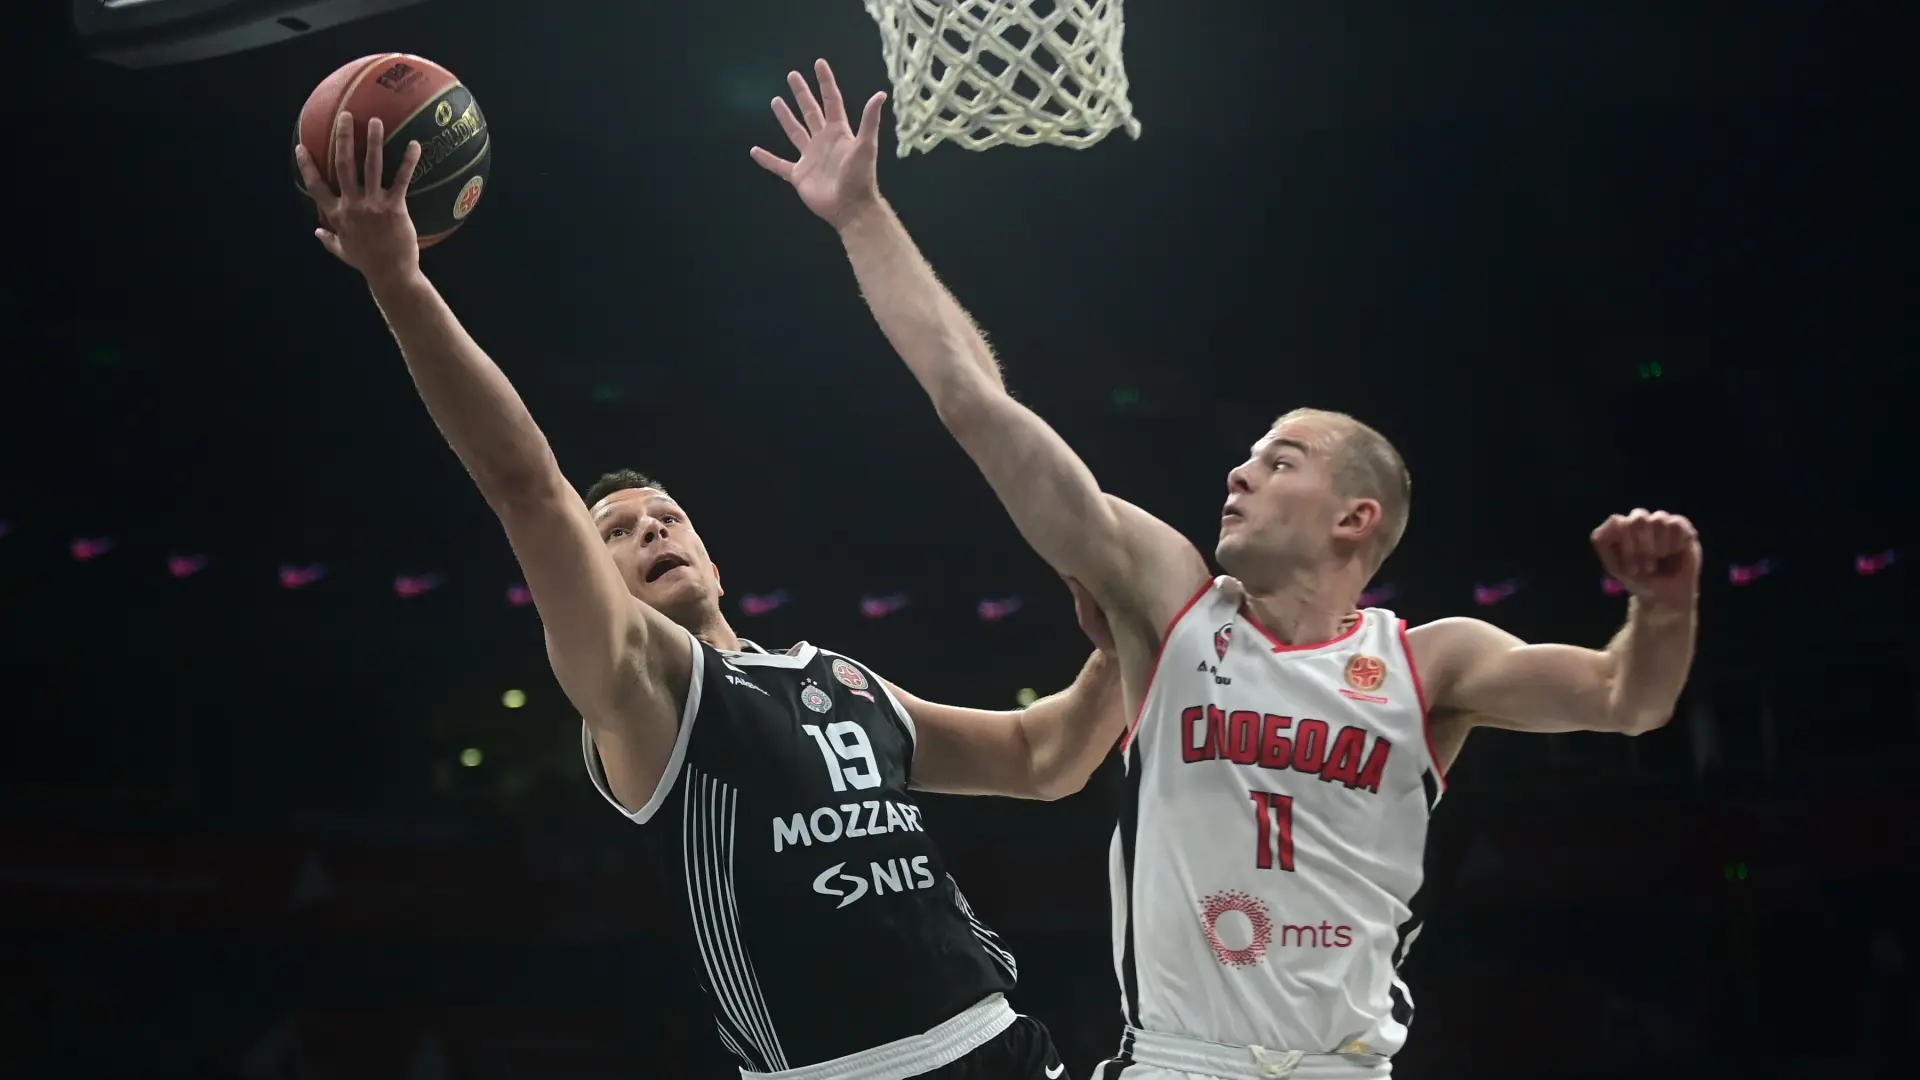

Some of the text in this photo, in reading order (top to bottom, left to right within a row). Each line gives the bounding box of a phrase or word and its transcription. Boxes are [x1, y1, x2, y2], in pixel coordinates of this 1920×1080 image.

[801, 720, 882, 792] 19
[1181, 703, 1392, 794] СЛОБОДА
[1249, 790, 1295, 872] 11
[870, 855, 935, 896] NIS
[1281, 919, 1353, 949] mts
